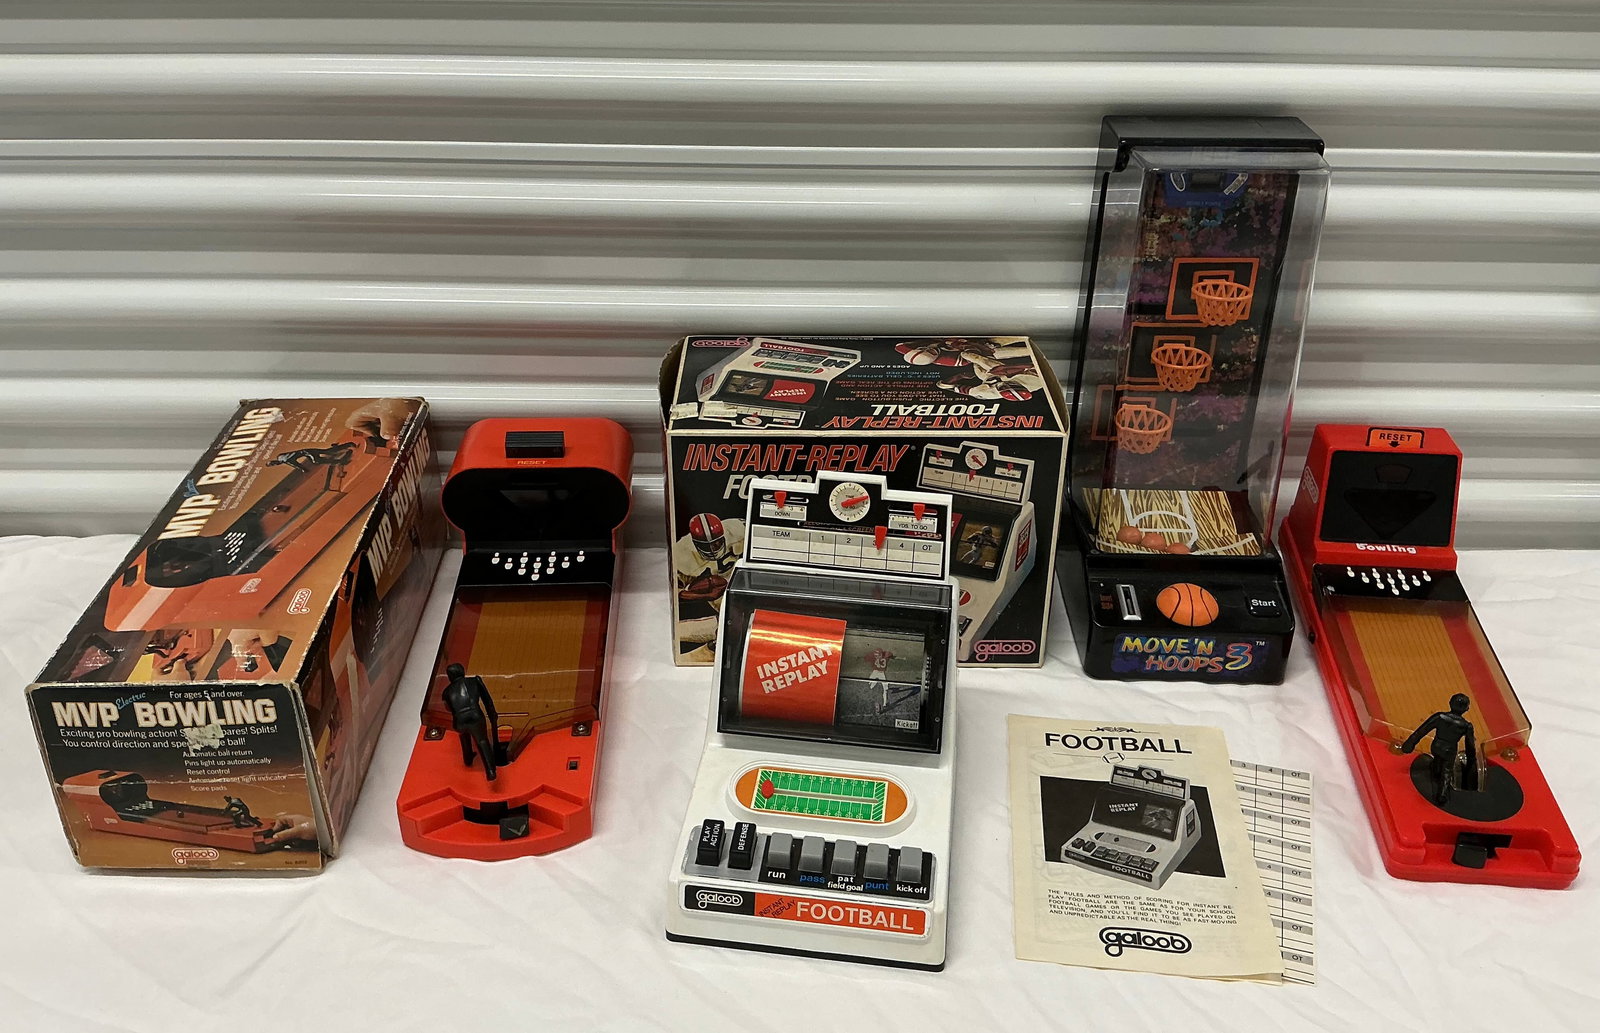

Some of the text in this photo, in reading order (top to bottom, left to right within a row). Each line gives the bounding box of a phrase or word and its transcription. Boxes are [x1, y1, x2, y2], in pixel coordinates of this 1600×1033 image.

[692, 337, 750, 348] galoob
[871, 404, 1000, 416] FOOTBALL
[821, 415, 1043, 428] INSTANT-REPLAY
[1379, 432, 1412, 441] RESET
[682, 444, 910, 472] INSTANT-REPLAY
[158, 494, 221, 540] MVP
[198, 407, 282, 486] BOWLING
[367, 512, 392, 587] MVP
[391, 428, 430, 529] BOWLING
[1251, 599, 1276, 608] Start
[974, 640, 1036, 662] galoob
[1122, 636, 1191, 654] MOVE
[756, 643, 833, 679] INSTANT
[874, 658, 886, 669] 43
[1145, 654, 1224, 672] HOOPS
[1225, 642, 1253, 671] 3
[761, 660, 829, 694] REPLAY
[116, 692, 146, 710] Electric
[169, 691, 182, 699] For
[204, 690, 209, 698] 5
[51, 702, 120, 728] MVP
[133, 698, 277, 728] BOWLING
[60, 728, 95, 738] Exciting
[113, 730, 147, 739] bowling
[148, 729, 178, 738] action!
[250, 725, 278, 735] Splits!
[896, 720, 918, 729] Kickoff
[112, 740, 151, 748] direction
[227, 738, 246, 746] ball!
[1044, 732, 1192, 754] FOOTBALL
[703, 825, 711, 842] PLAY
[710, 824, 721, 846] ACTION
[738, 823, 749, 850] DEFENSE
[173, 848, 218, 865] galoob
[767, 870, 786, 879] run
[799, 874, 826, 883] pass
[1112, 865, 1150, 879] FOOTBALL
[846, 884, 863, 892] goal
[865, 882, 889, 890] punt
[896, 884, 914, 893] kick
[696, 890, 743, 908] galoob
[759, 898, 785, 918] INSTANT
[771, 900, 796, 917] REPLAY
[796, 902, 914, 930] FOOTBALL
[1064, 911, 1115, 919] UNPREDICTABLE
[1099, 926, 1192, 957] galoob
